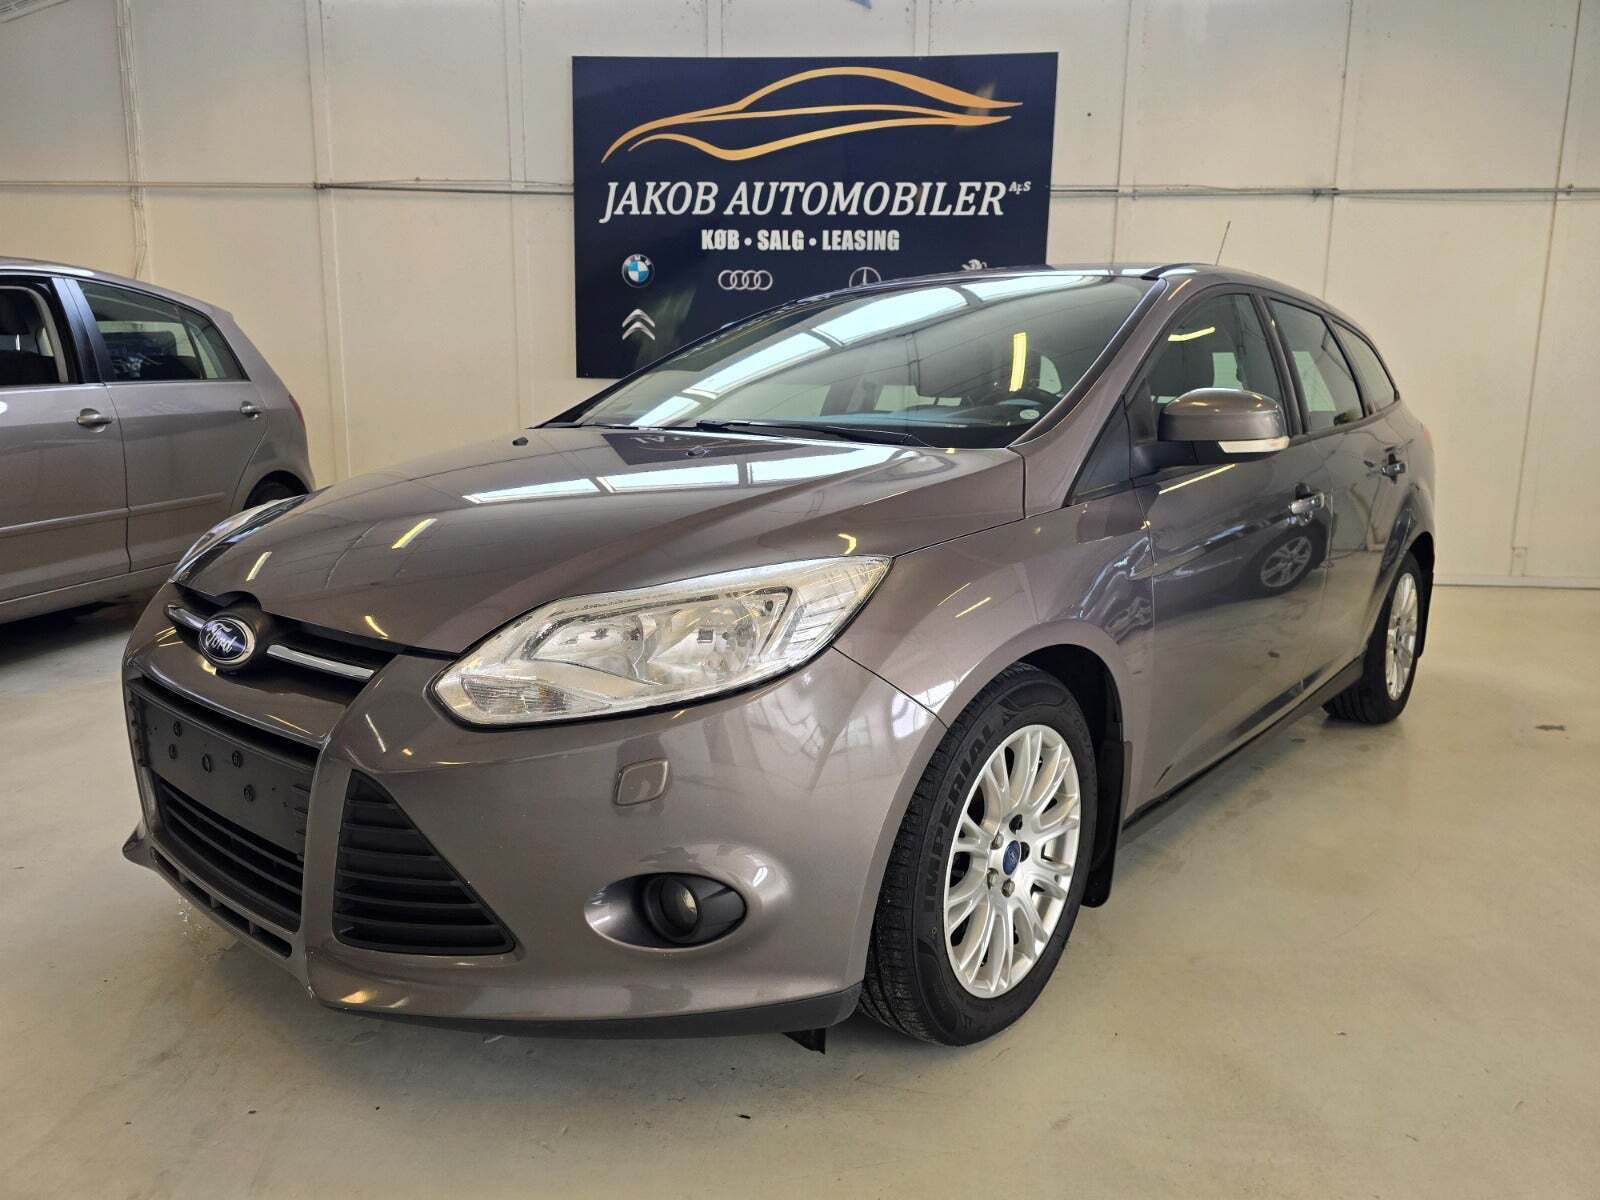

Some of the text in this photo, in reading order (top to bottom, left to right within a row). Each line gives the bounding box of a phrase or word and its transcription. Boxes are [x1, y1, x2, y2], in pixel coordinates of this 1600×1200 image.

[599, 181, 718, 223] JAKOB
[723, 181, 1006, 215] AUTOMOBILER
[701, 229, 899, 250] KØB SALG LEASING
[205, 622, 237, 653] Ford
[924, 725, 993, 913] IMPERIAL
